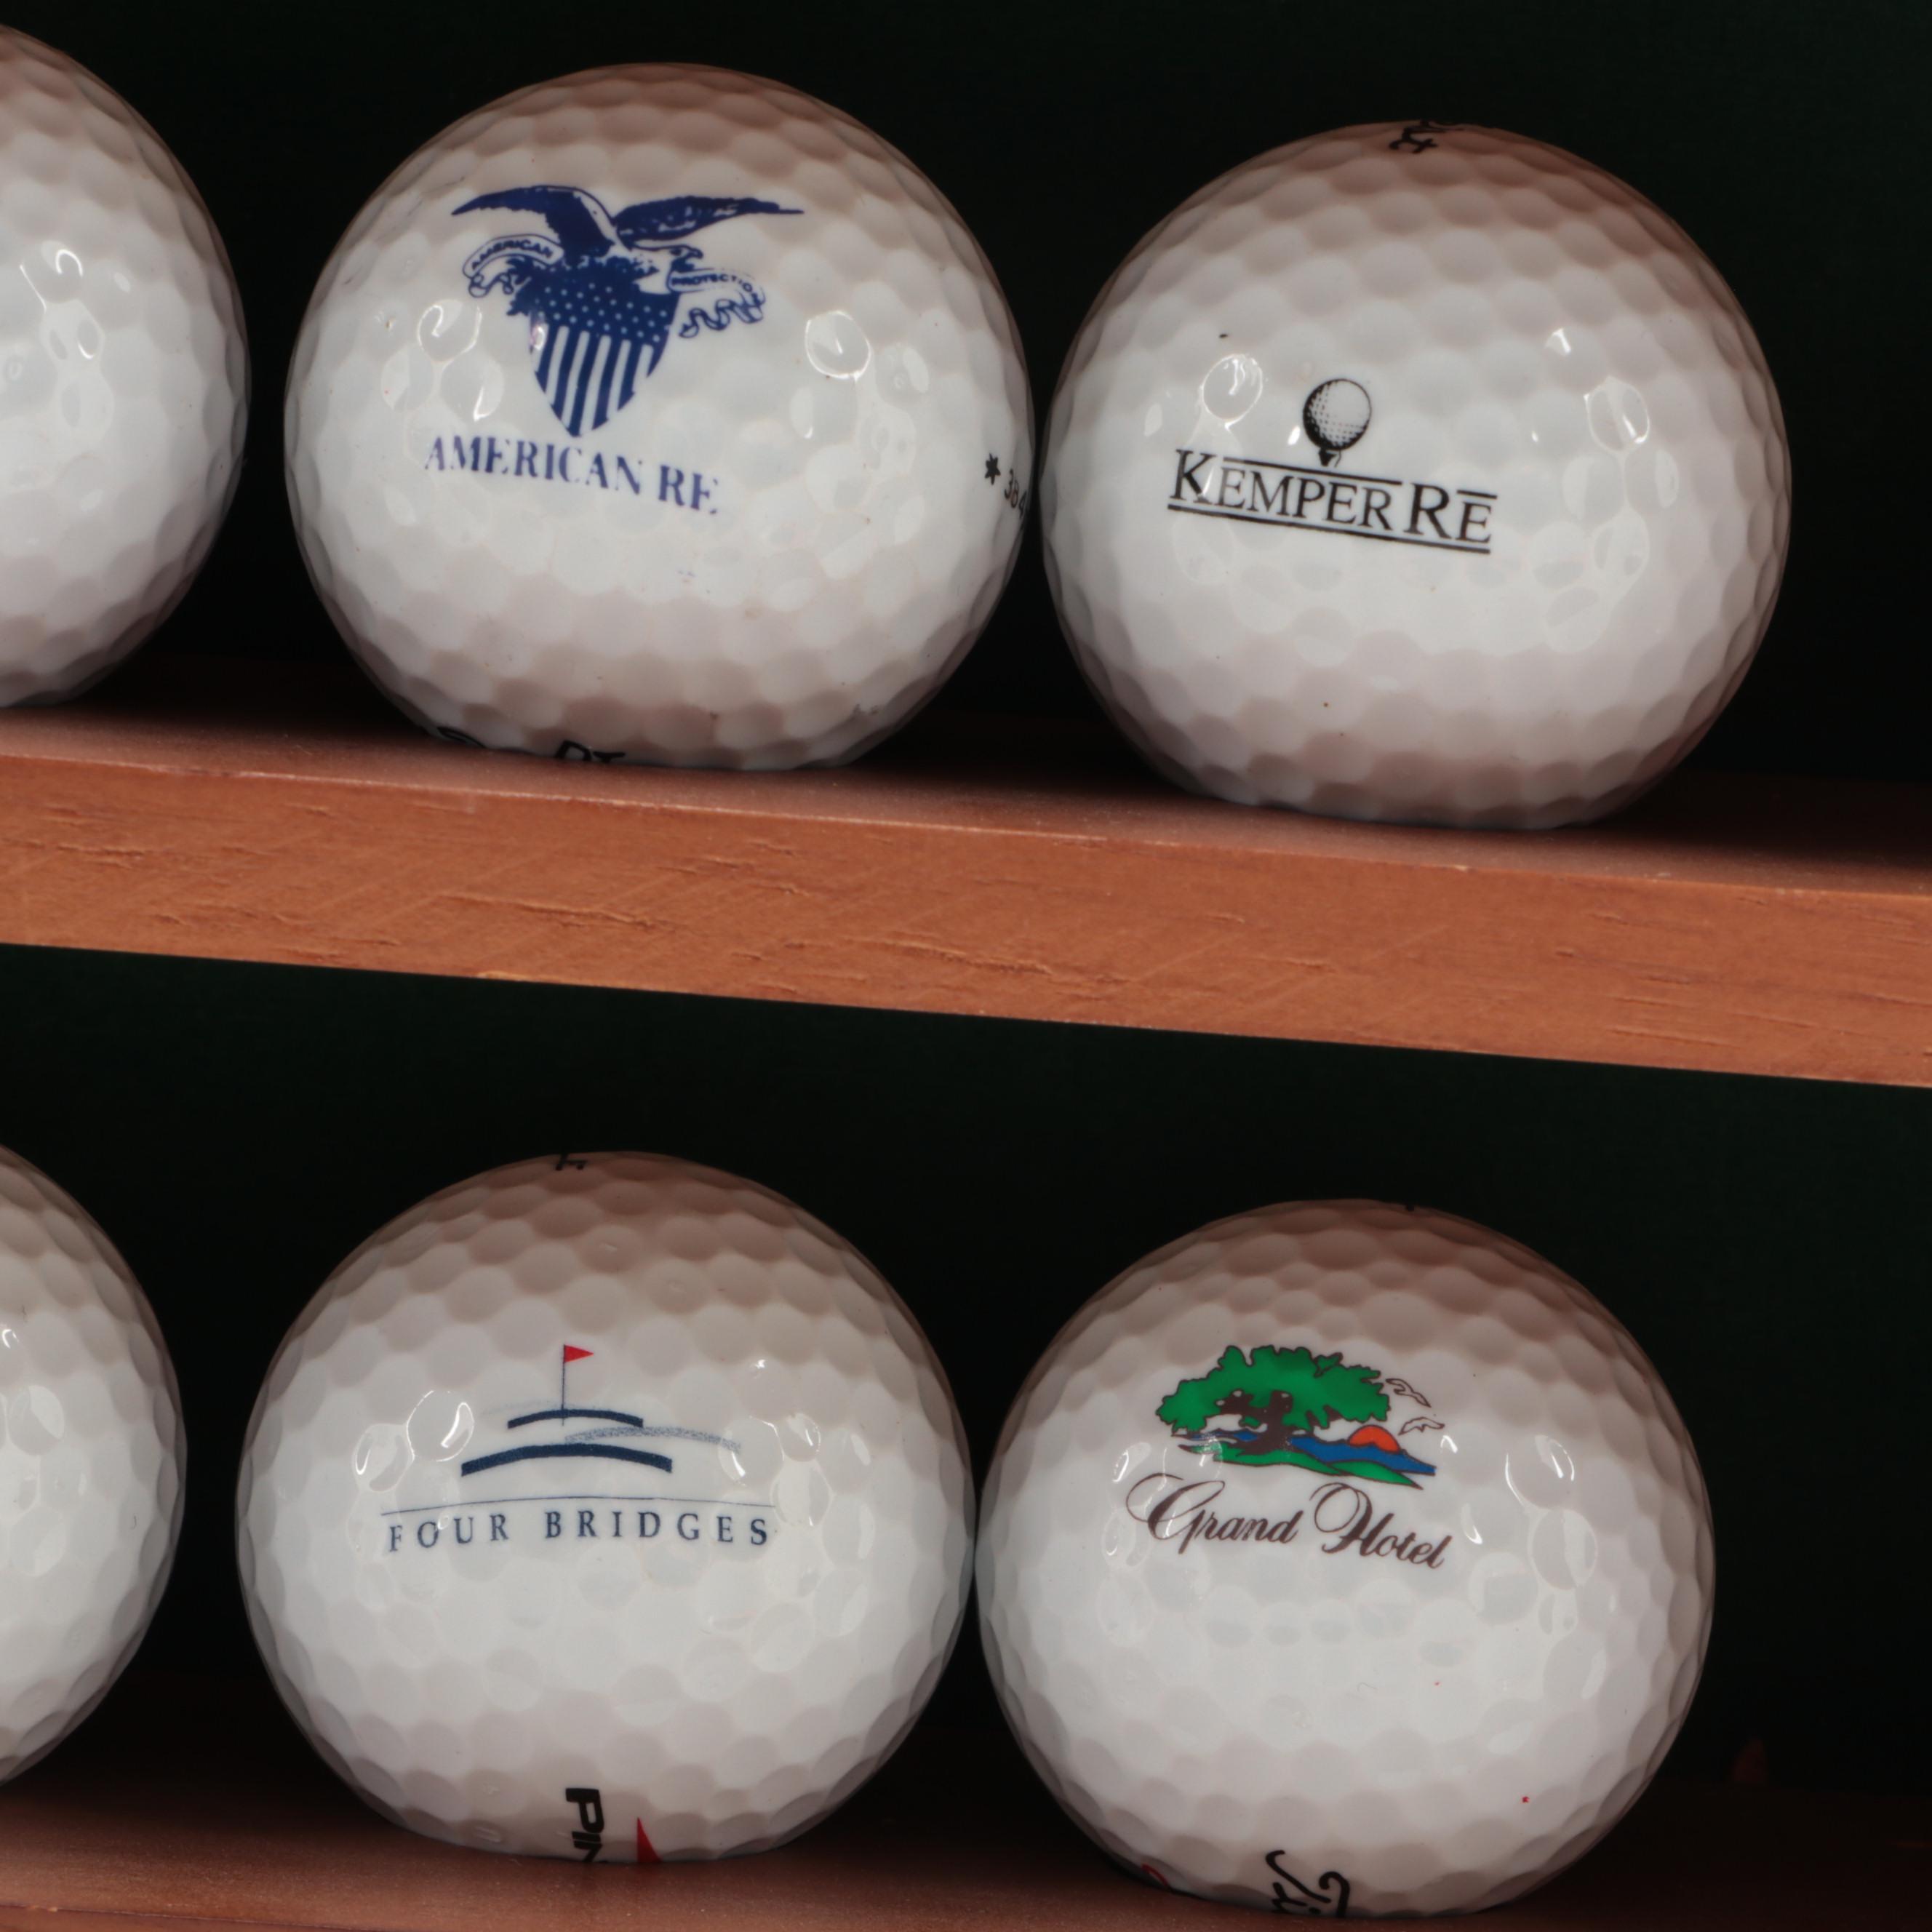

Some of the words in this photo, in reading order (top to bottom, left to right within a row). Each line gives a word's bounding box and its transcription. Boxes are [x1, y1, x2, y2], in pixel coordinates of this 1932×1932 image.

[471, 239, 554, 271] AMERICAN
[425, 435, 643, 495] AMERICAN
[658, 465, 718, 514] RE
[1169, 449, 1394, 532] KEMPER
[1402, 482, 1493, 544] RE
[389, 1512, 509, 1552] FOUR
[543, 1509, 769, 1546] BRIDGES
[1125, 1472, 1304, 1554] Grand
[1309, 1482, 1453, 1569] Hotel
